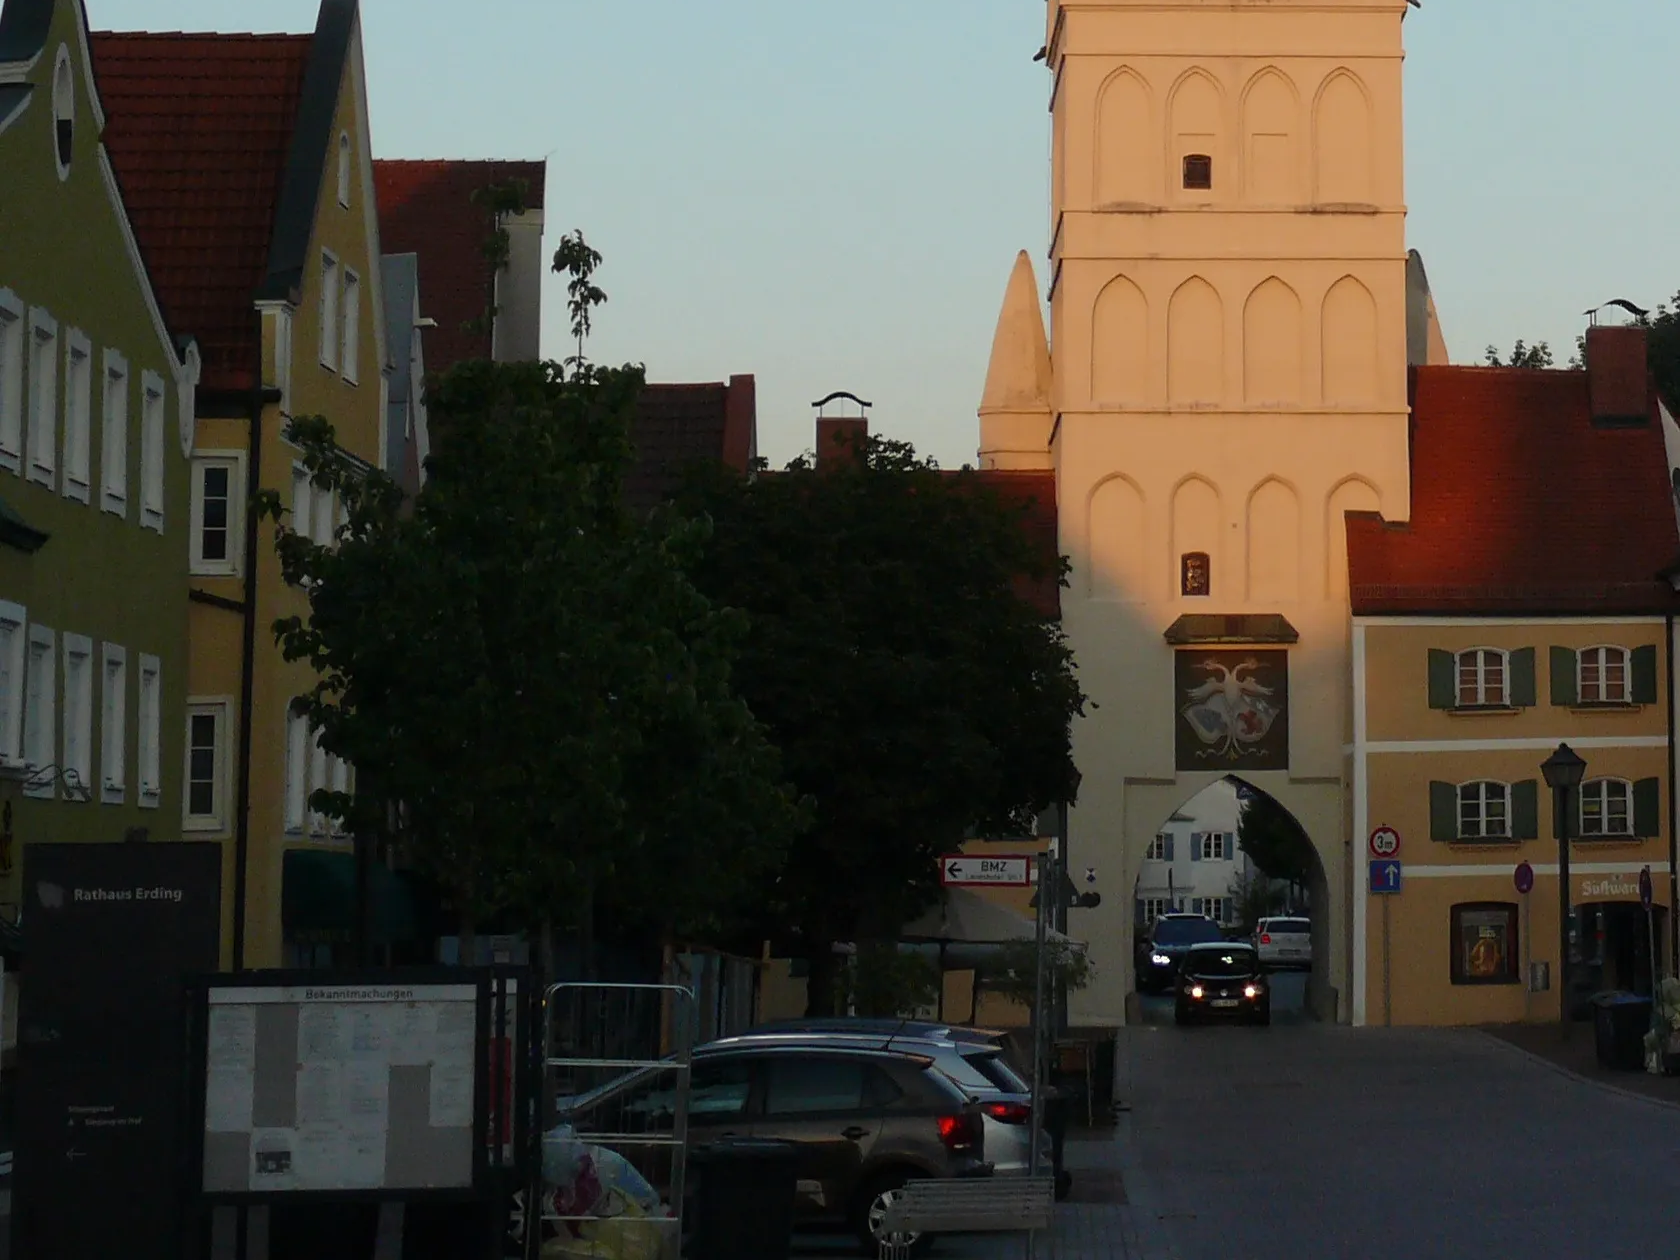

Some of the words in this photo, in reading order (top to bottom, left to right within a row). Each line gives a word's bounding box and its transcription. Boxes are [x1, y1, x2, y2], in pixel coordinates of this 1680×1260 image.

[981, 861, 1008, 872] BMZ
[74, 888, 133, 901] Rathaus
[136, 887, 183, 902] Erding
[305, 989, 414, 1001] Bekanntmachungen
